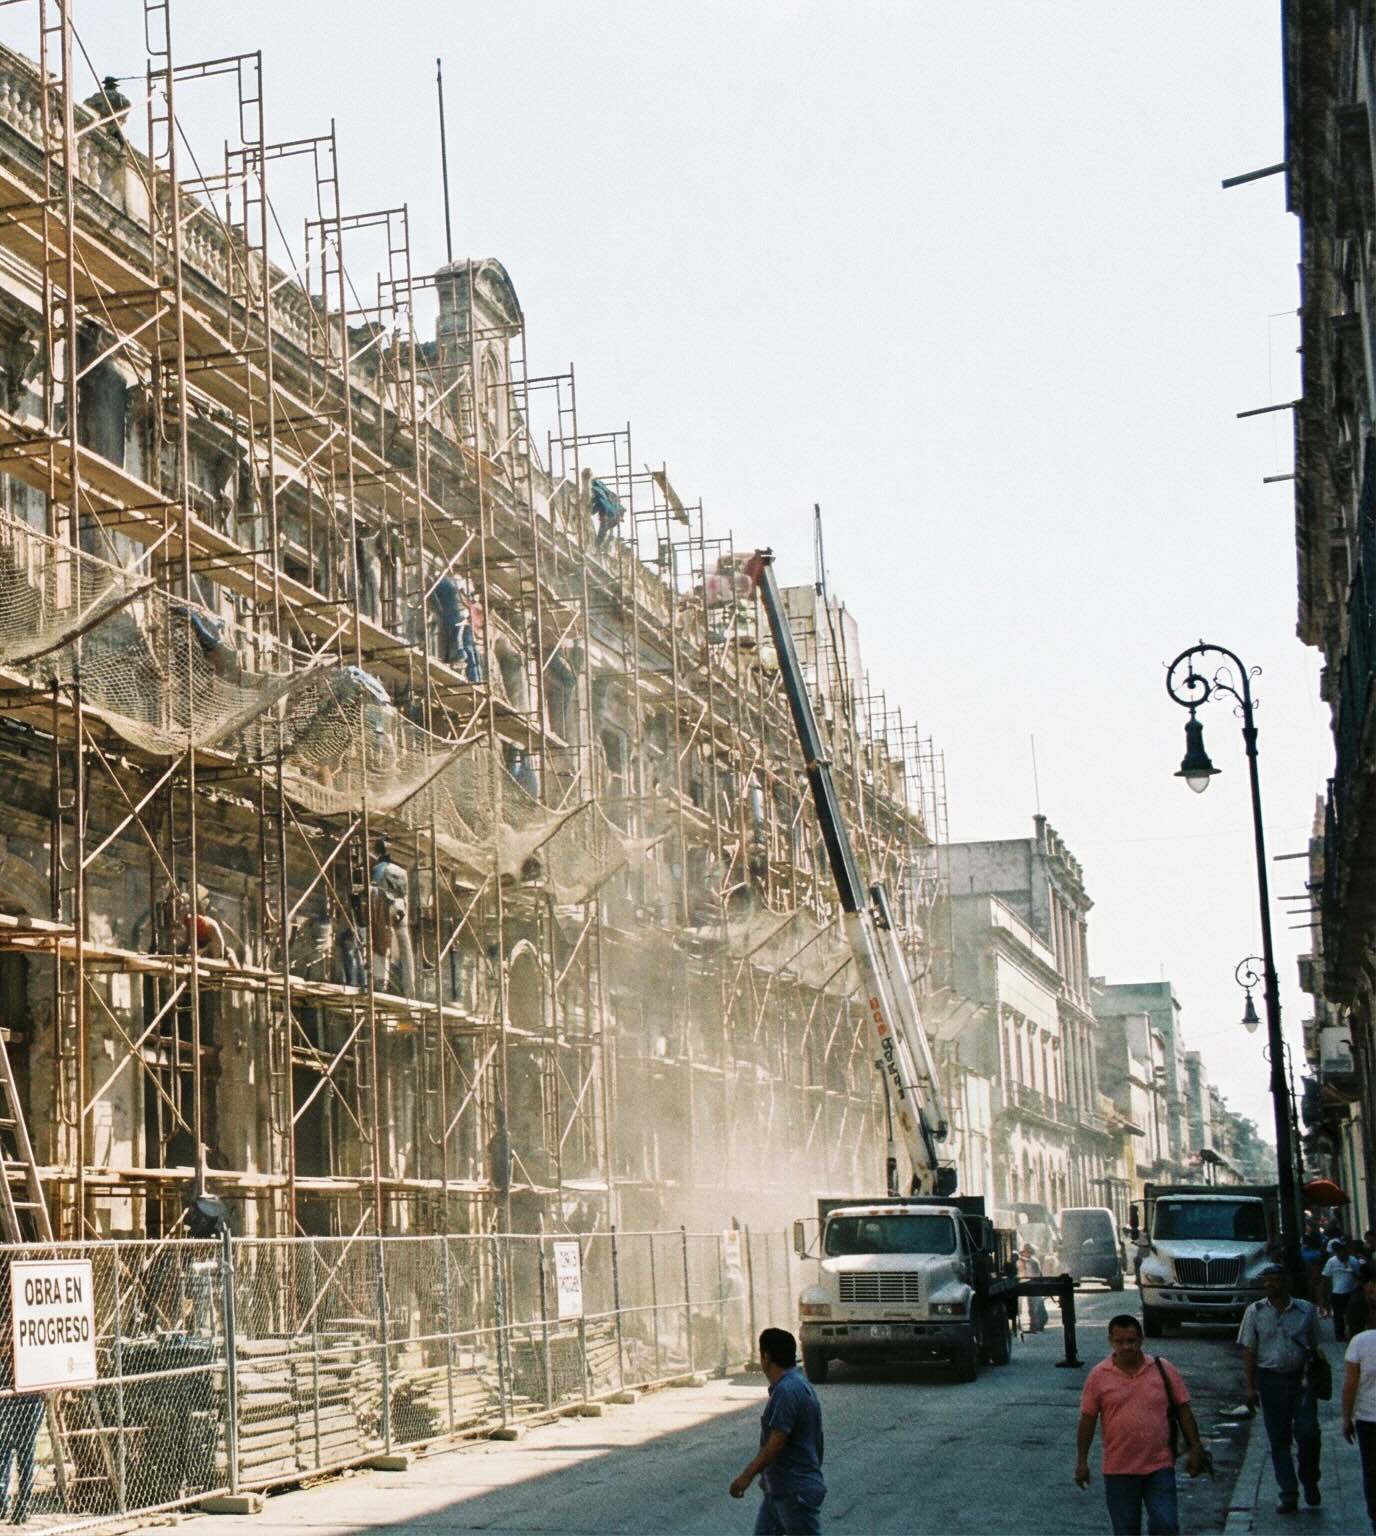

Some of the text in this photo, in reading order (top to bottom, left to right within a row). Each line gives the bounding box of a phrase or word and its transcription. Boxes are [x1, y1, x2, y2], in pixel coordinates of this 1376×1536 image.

[25, 1276, 82, 1306] OBRA EN
[19, 1315, 89, 1347] PROGRESO
